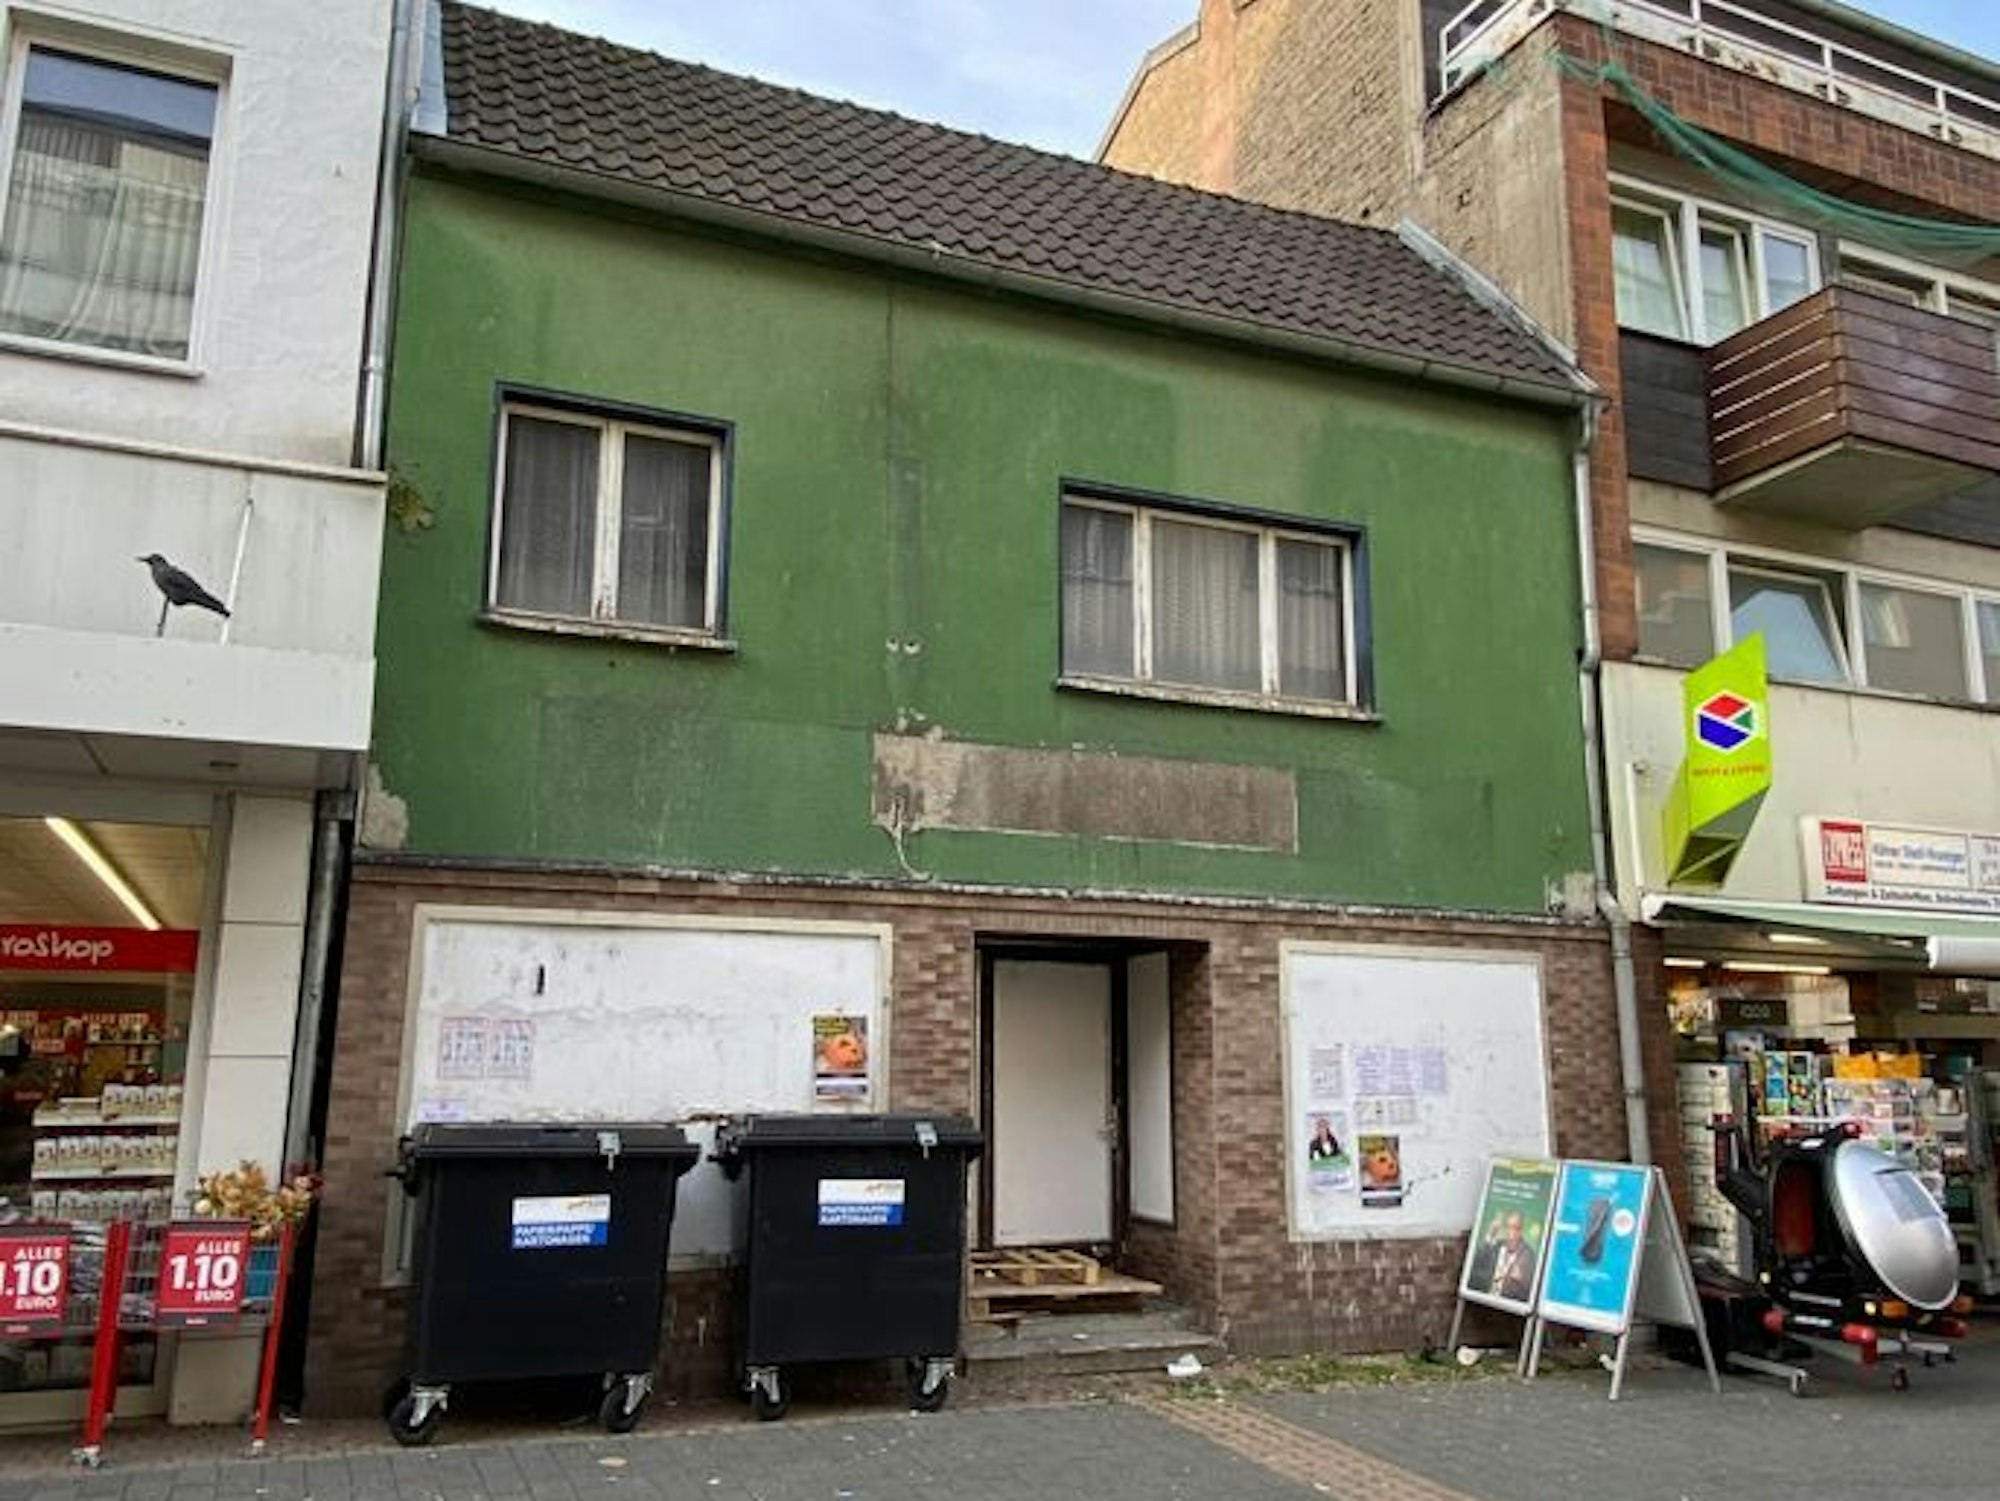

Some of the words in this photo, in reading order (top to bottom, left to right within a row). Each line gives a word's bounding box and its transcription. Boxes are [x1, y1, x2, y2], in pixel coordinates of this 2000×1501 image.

[14, 1246, 62, 1260] ALLES
[195, 1241, 240, 1254] ALLES
[170, 1255, 238, 1290] 1.10
[194, 1289, 235, 1302] EURO
[15, 1296, 57, 1310] EURO
